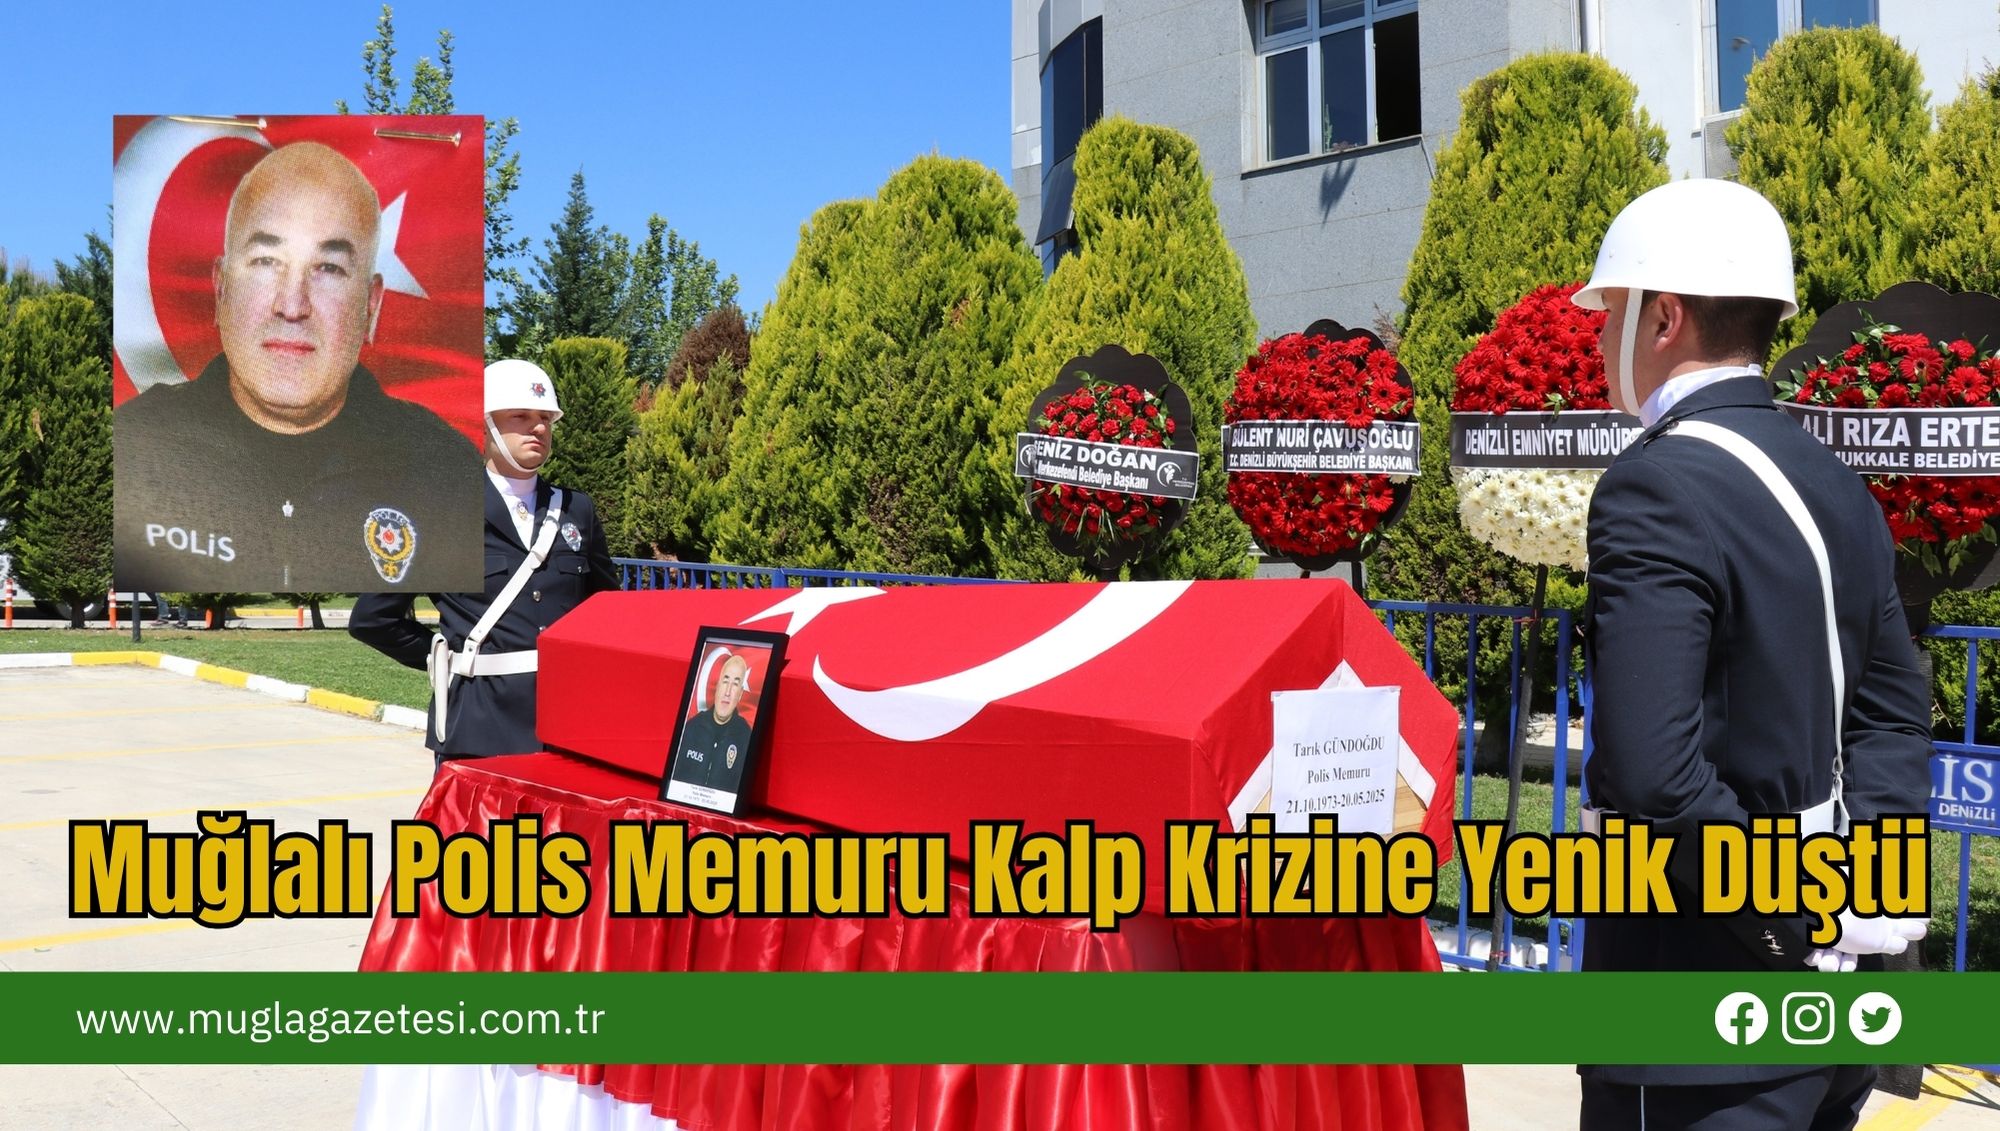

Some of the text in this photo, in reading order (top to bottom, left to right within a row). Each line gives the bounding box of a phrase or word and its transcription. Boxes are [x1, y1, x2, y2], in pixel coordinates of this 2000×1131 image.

[1232, 422, 1413, 453] BÜLENT NURİ ÇAVUŞOĞLU
[1465, 423, 1509, 456] DENİZLİ
[1512, 423, 1573, 456] EMNİYET
[1802, 409, 1833, 446] ALİ
[1843, 417, 1911, 447] RIZA
[1077, 446, 1157, 471] DOĞAN
[1240, 451, 1265, 467] DENİZLİ
[1267, 451, 1318, 470] BÜYÜKŞEHİR
[1319, 452, 1365, 469] BELEDİYE
[1368, 454, 1412, 472] BAŞKANI
[1914, 449, 2000, 468] BELEDİYE
[1078, 467, 1112, 488] Belediye
[1113, 471, 1149, 492] Başkanı
[1293, 735, 1385, 757] Tarık GÜNDOĞDU
[1307, 767, 1371, 784] Polis Memuru
[1930, 754, 1993, 803] İS
[1286, 789, 1385, 814] 21.10.1973-20.05.2025
